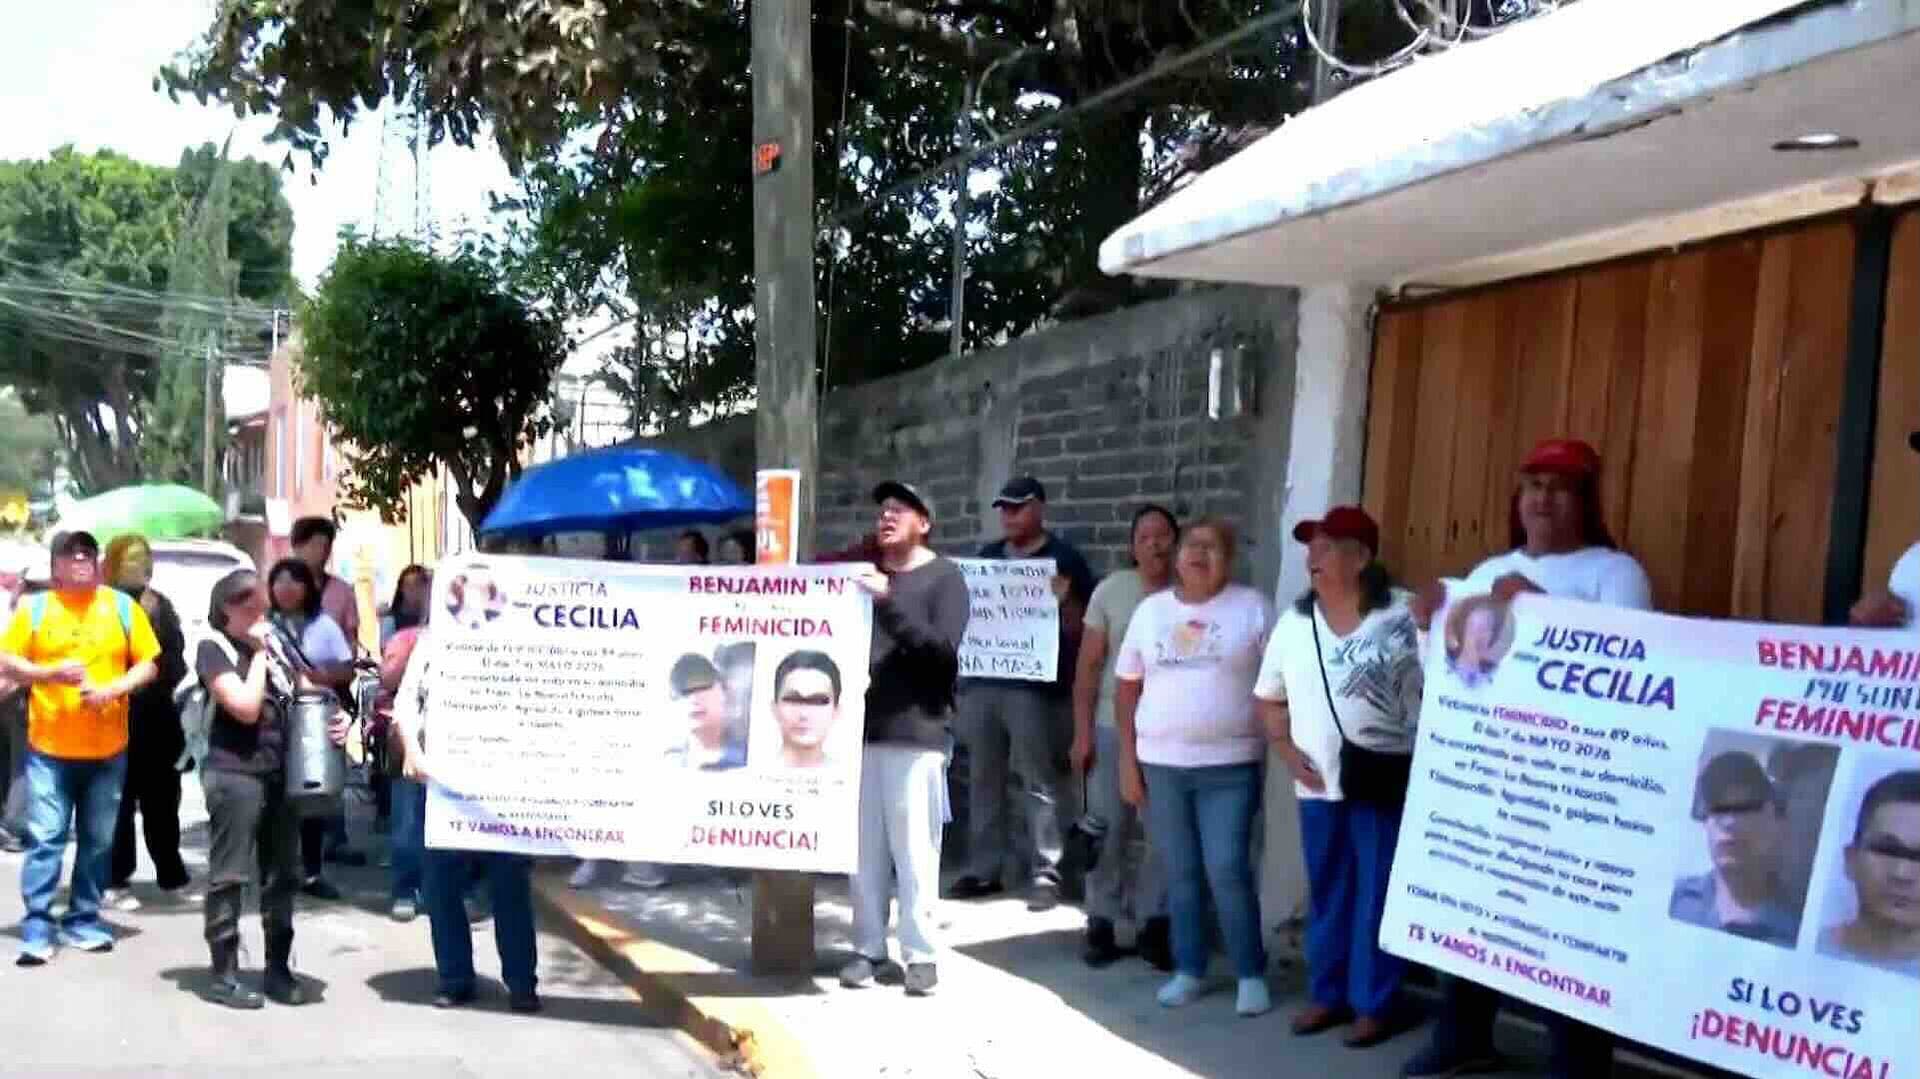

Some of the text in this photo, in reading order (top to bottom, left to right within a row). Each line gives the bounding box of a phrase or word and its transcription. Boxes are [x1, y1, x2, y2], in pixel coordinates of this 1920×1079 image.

[689, 576, 808, 595] BENJAMIN
[533, 604, 640, 630] CECILIA
[699, 615, 834, 637] FEMINICIDA
[1532, 625, 1646, 661] JUSTICIA
[1536, 659, 1675, 710] CECILIA
[707, 800, 723, 816] SI
[759, 802, 794, 820] VES
[1430, 930, 1487, 964] VAMOS
[1504, 955, 1611, 1008] ENCONTRAR
[1727, 977, 1864, 1034] SI LO VES
